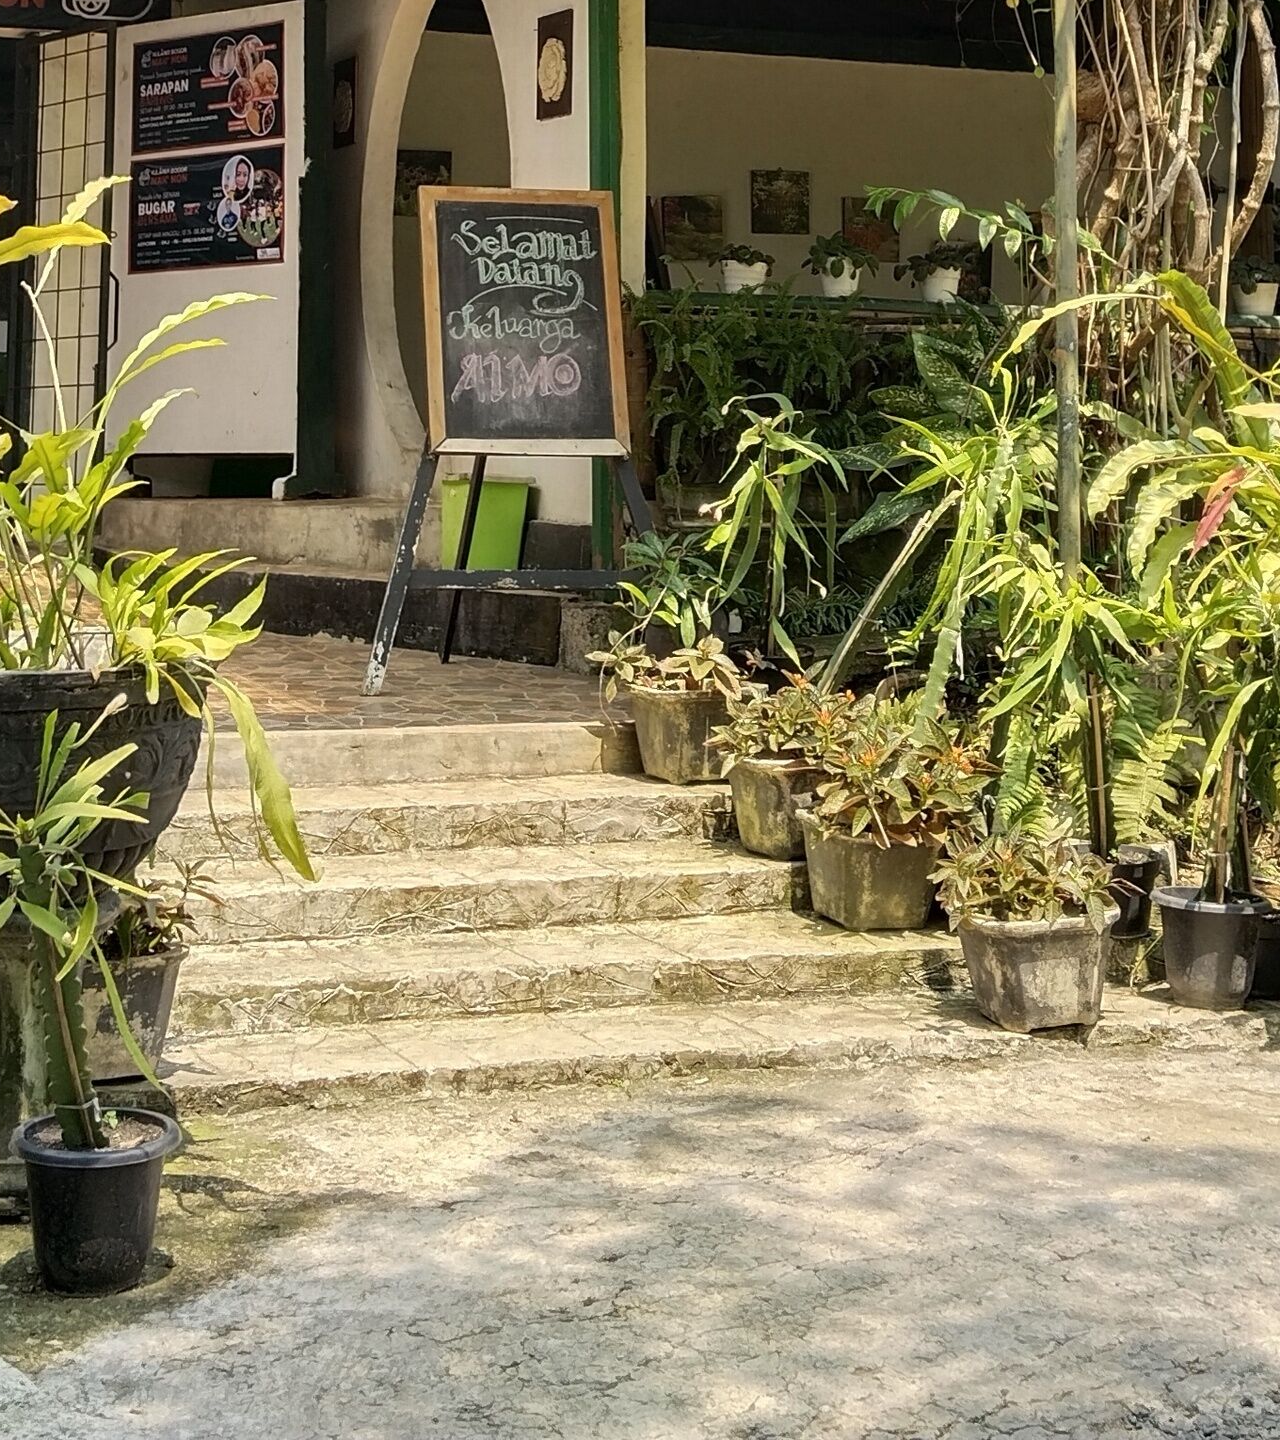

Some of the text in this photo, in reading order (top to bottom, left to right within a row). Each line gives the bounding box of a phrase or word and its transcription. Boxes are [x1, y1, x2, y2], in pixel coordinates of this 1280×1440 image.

[140, 78, 189, 97] SARAPAN
[138, 200, 176, 216] BUGAR
[451, 219, 597, 260] Selamat
[471, 256, 585, 317] Datang
[446, 304, 581, 354] Keluarga
